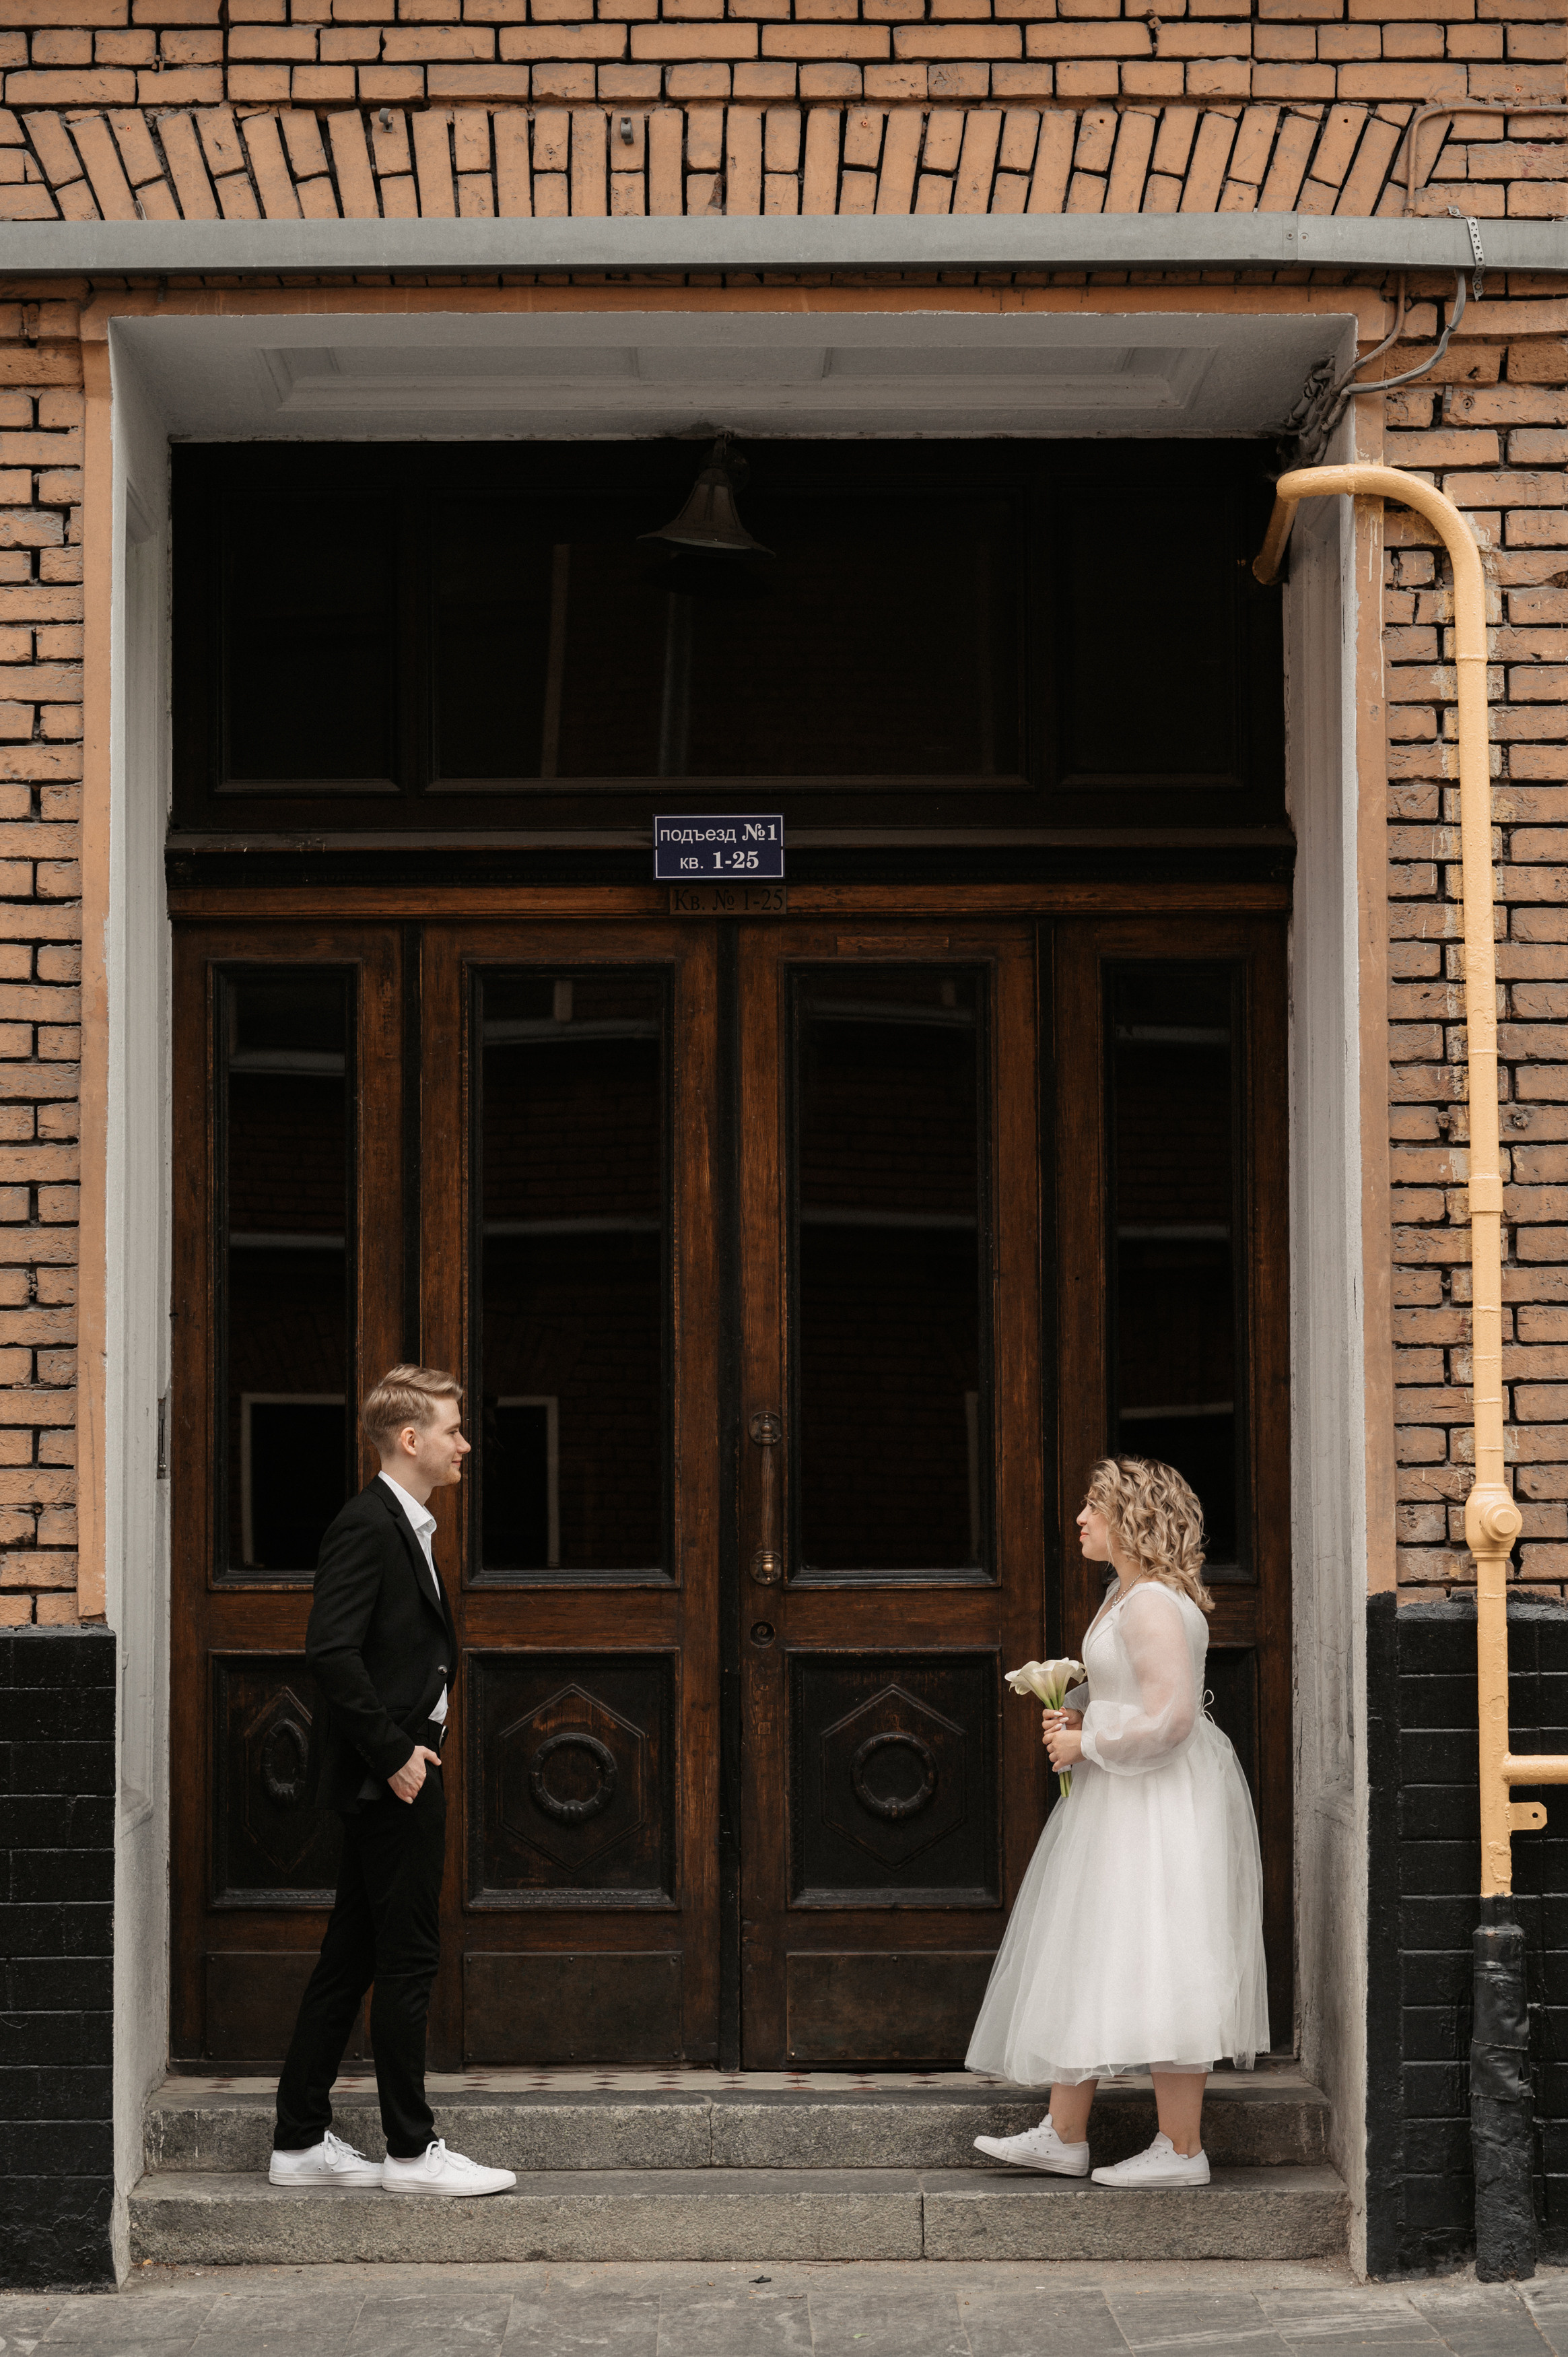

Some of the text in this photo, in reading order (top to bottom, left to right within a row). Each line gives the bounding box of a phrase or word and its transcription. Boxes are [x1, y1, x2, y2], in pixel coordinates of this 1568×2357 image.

[660, 823, 778, 844] подъезд №1
[680, 851, 759, 869] кв. 1-25
[674, 889, 783, 910] Кв. № 1-25
